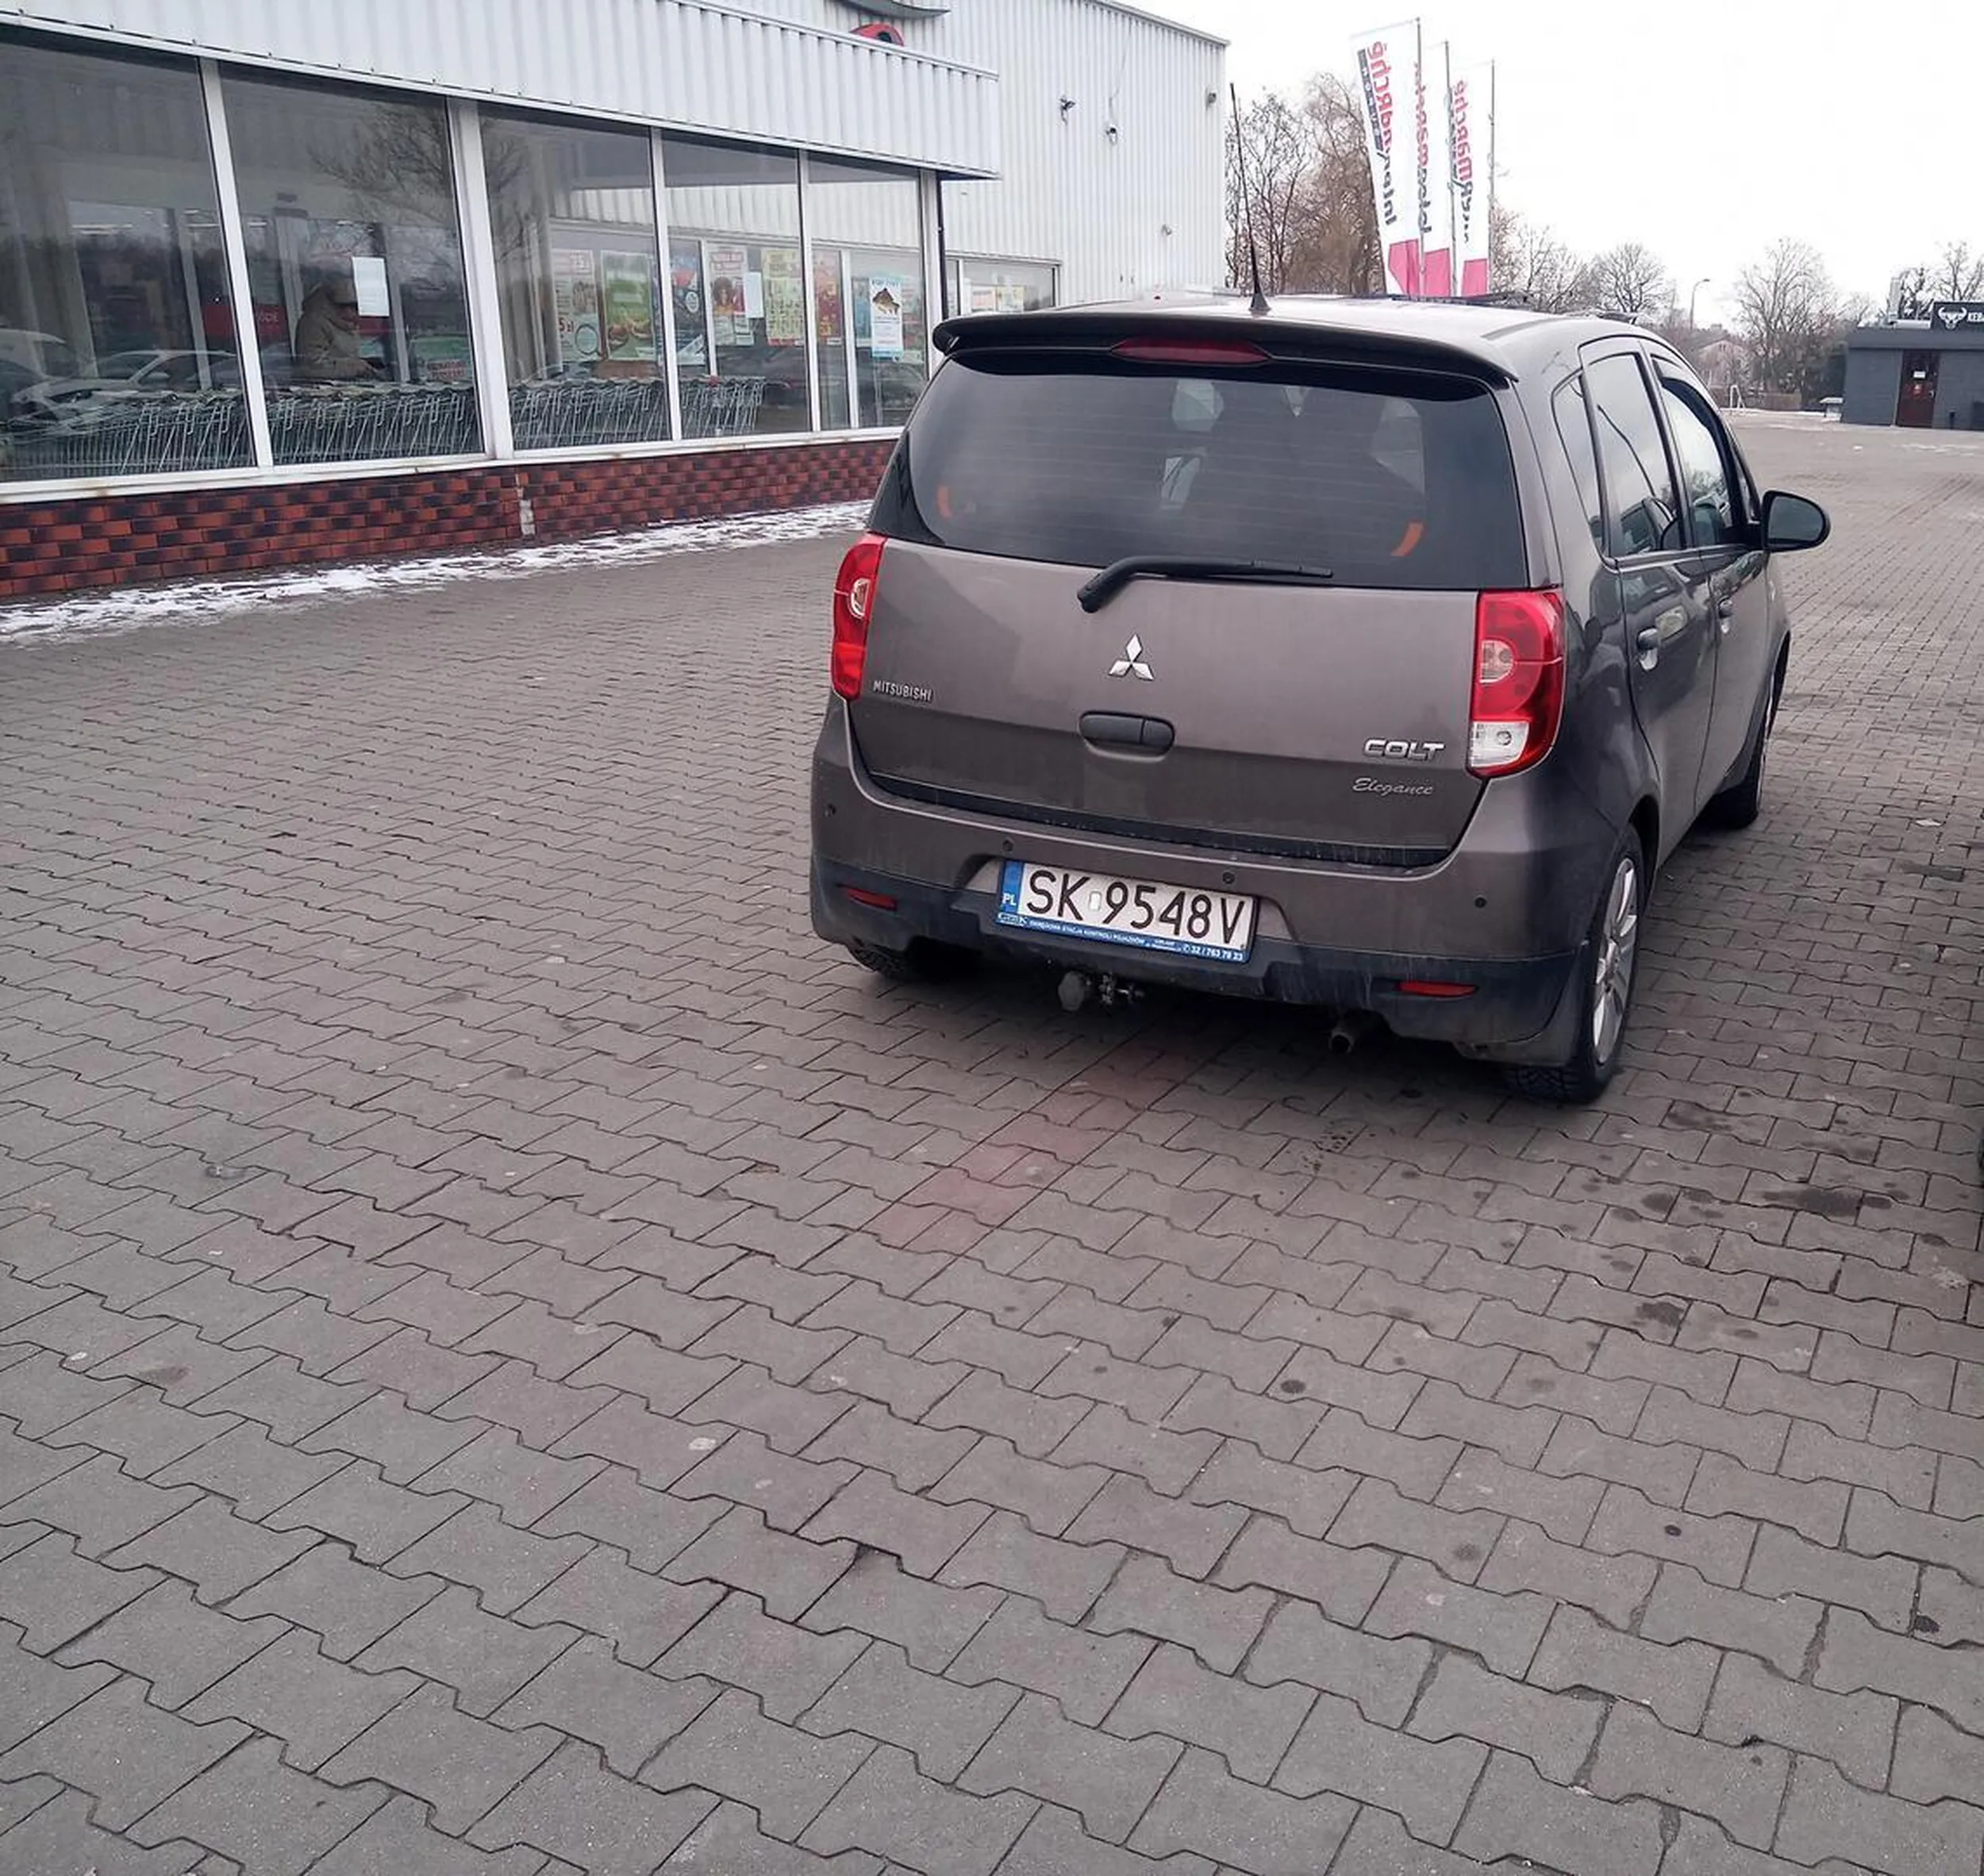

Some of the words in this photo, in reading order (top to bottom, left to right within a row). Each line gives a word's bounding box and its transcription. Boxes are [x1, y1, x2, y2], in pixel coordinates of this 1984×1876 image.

[873, 680, 932, 702] MITSUBISHI
[1364, 739, 1444, 761] COLT
[1352, 777, 1433, 796] Elegance
[1002, 892, 1017, 908] PL
[1026, 870, 1091, 921] SK
[1102, 881, 1246, 944] 9548V
